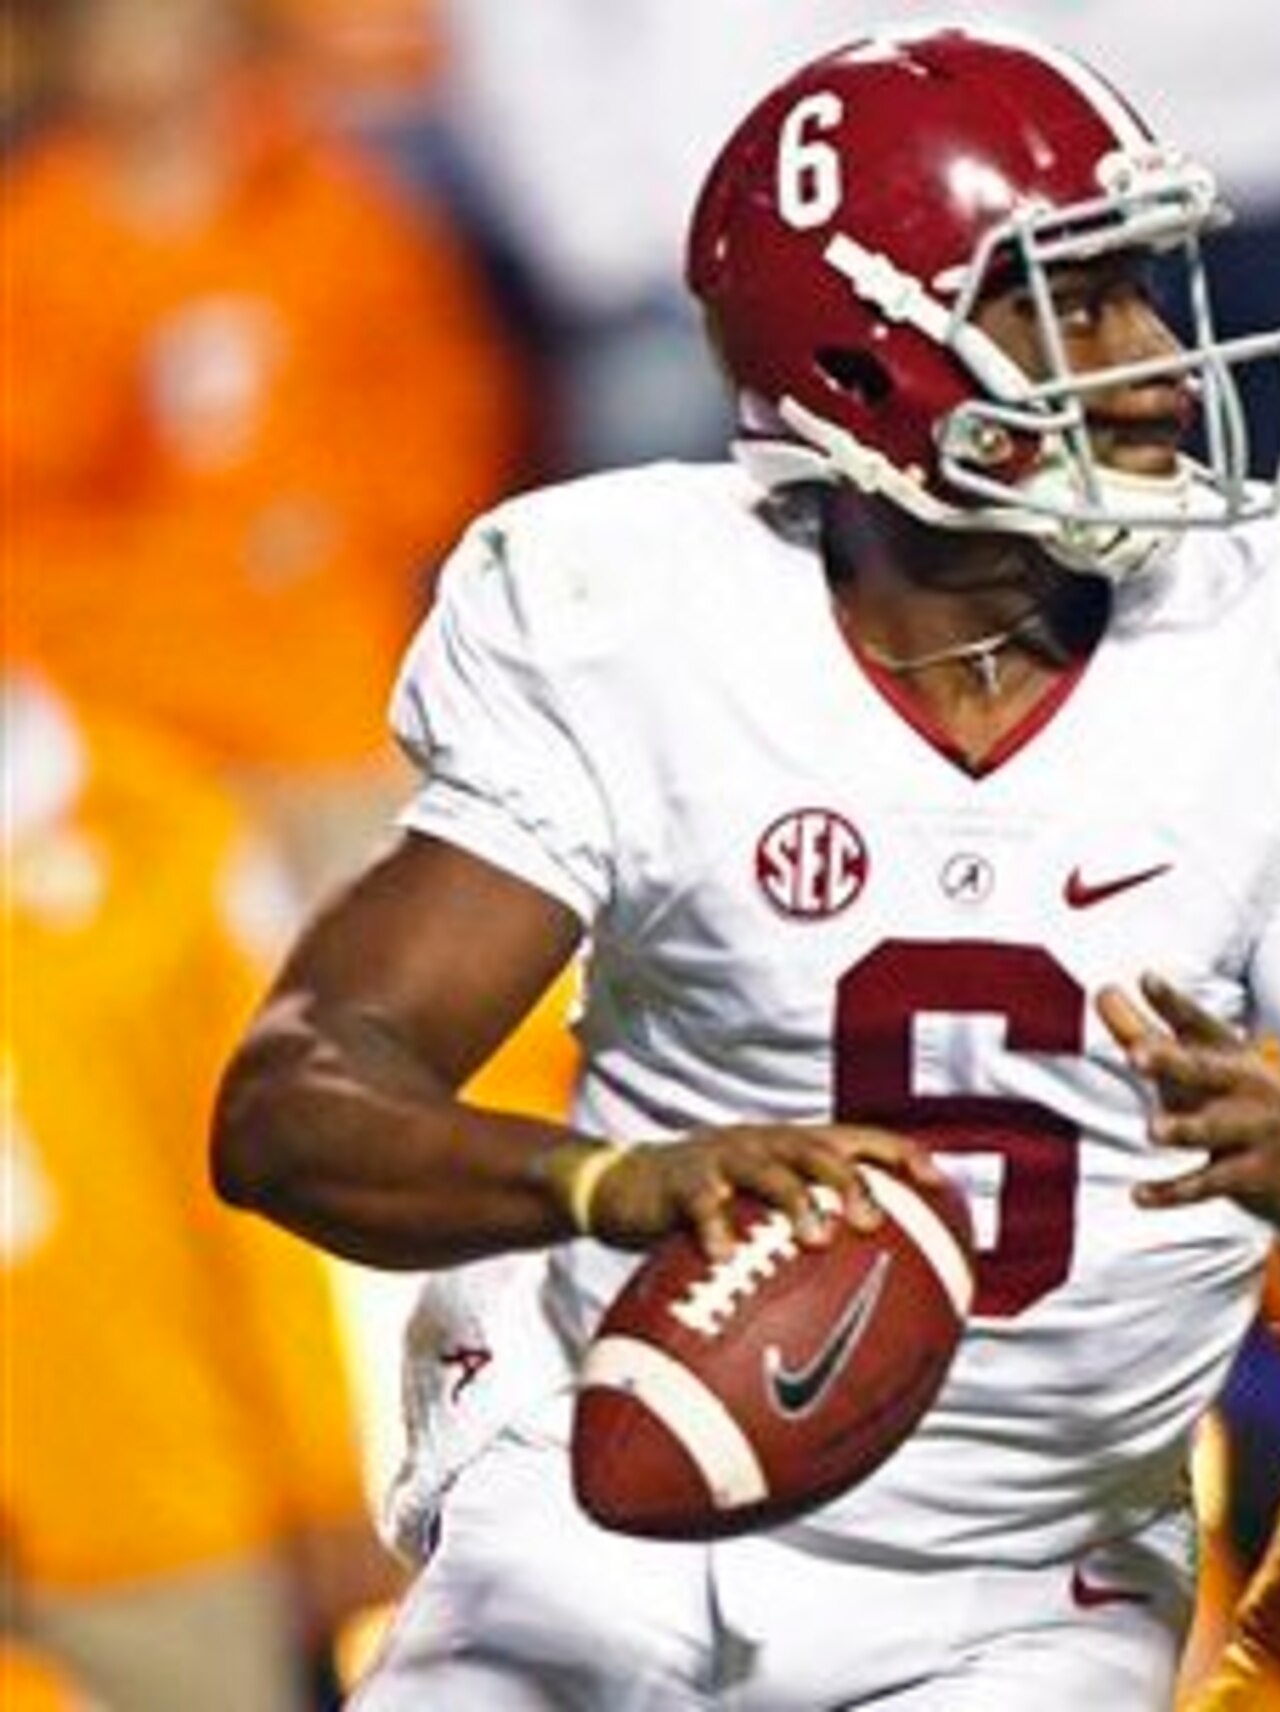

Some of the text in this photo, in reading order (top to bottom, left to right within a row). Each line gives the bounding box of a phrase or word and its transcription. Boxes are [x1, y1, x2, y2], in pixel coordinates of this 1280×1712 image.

[779, 91, 843, 230] 6
[762, 812, 864, 914] SEC
[833, 938, 1086, 1319] 6
